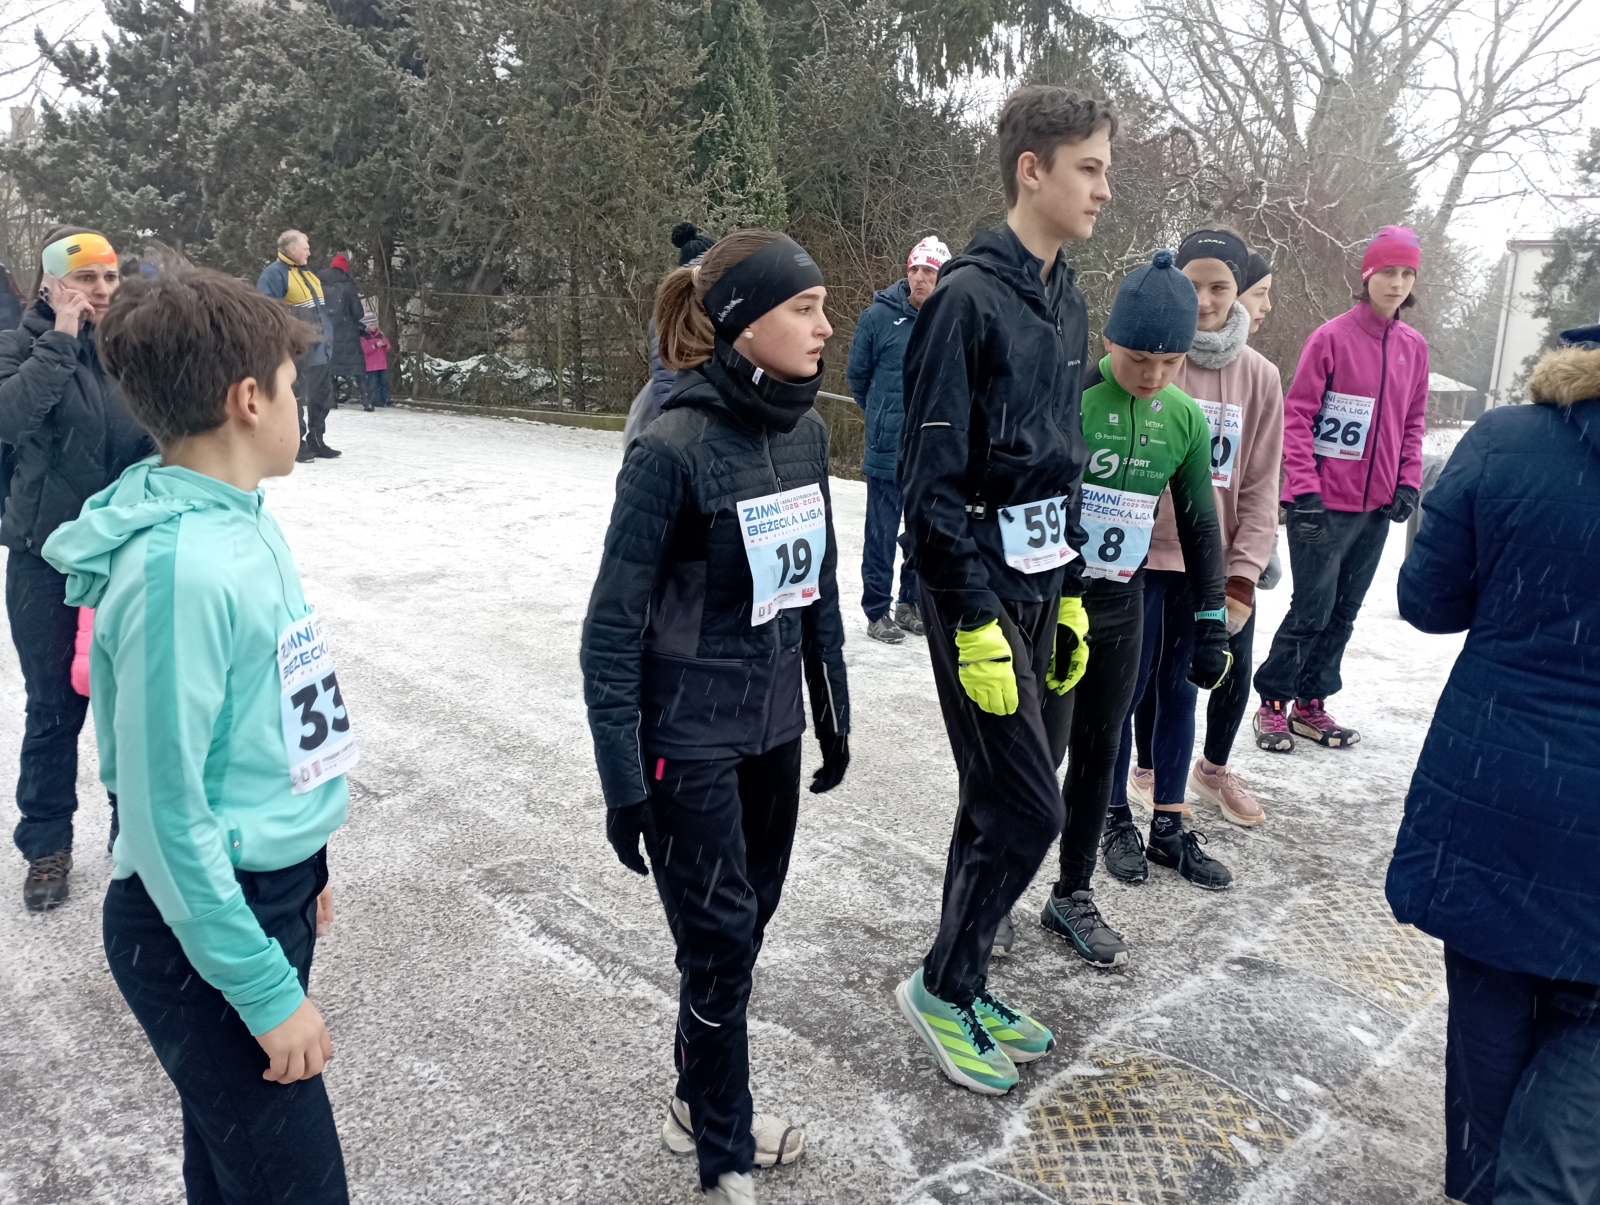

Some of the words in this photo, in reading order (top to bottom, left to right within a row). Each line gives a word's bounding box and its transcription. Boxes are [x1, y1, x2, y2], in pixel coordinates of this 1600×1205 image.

[1349, 407, 1370, 416] LIGA
[1214, 417, 1239, 429] LGA
[1103, 433, 1127, 441] Partners
[1122, 457, 1151, 468] SPORT
[1146, 470, 1165, 480] TEAM
[1081, 488, 1122, 506] ZIMNÍ
[743, 499, 782, 523] ZIMNÍ
[800, 507, 824, 523] LIGA
[1134, 512, 1153, 521] LIGA
[1024, 502, 1061, 549] 59
[1098, 527, 1125, 563] 8
[776, 537, 812, 590] 19
[290, 671, 350, 751] 33
